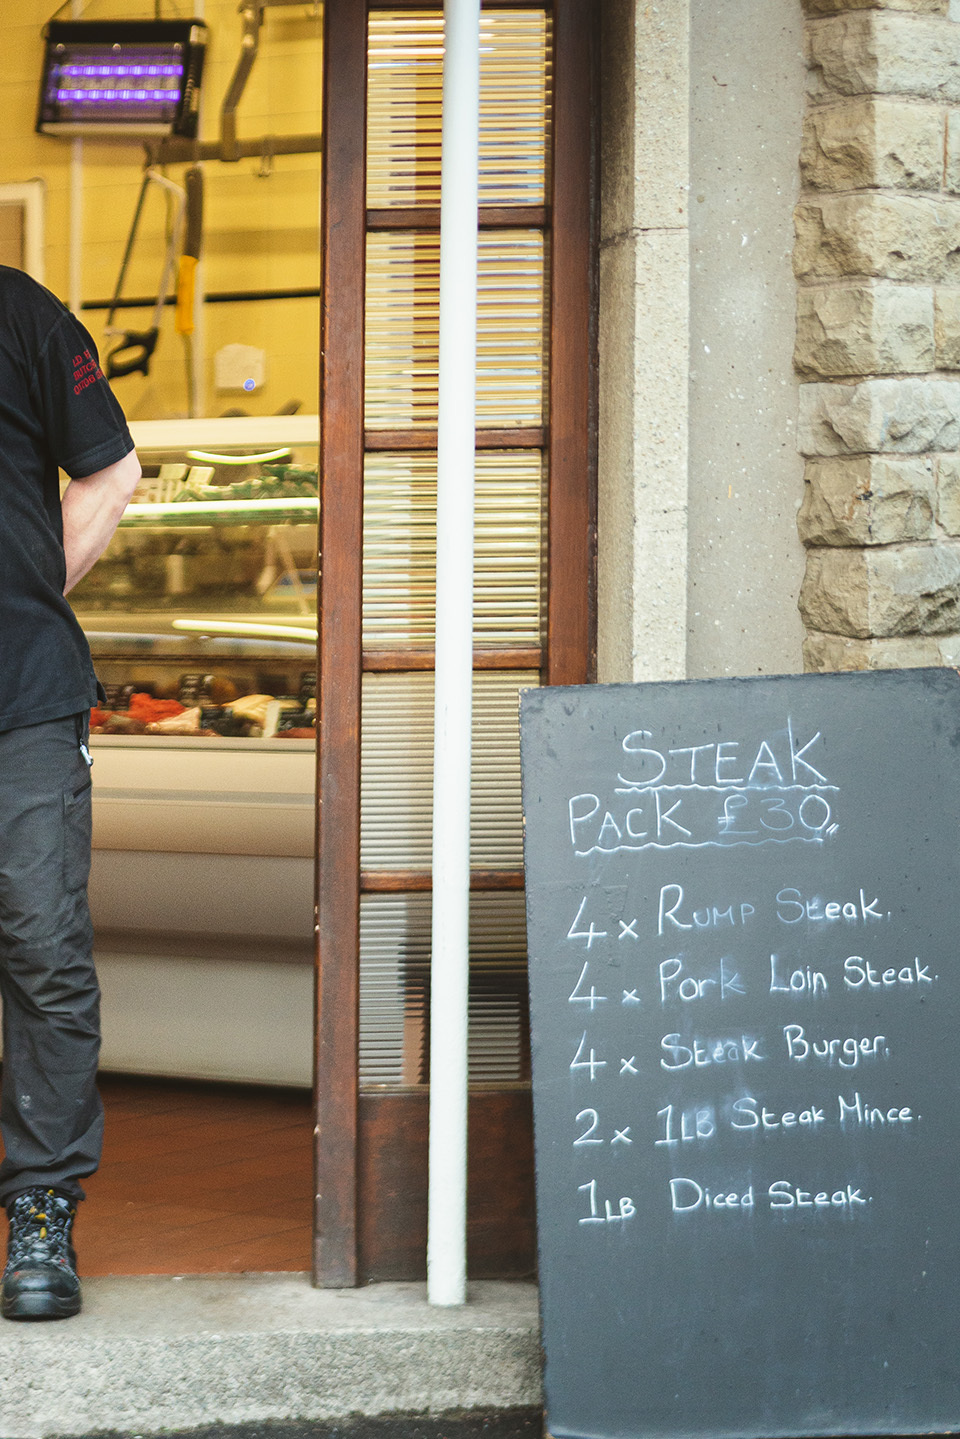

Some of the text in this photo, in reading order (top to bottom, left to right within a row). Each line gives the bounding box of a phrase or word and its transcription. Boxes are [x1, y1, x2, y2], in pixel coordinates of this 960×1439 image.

[617, 716, 828, 785] STEAK
[658, 957, 746, 1004] Pork
[769, 954, 828, 997] Loin
[660, 1033, 765, 1072] Steak
[731, 1096, 826, 1131] Steak
[668, 1177, 755, 1216] Diced
